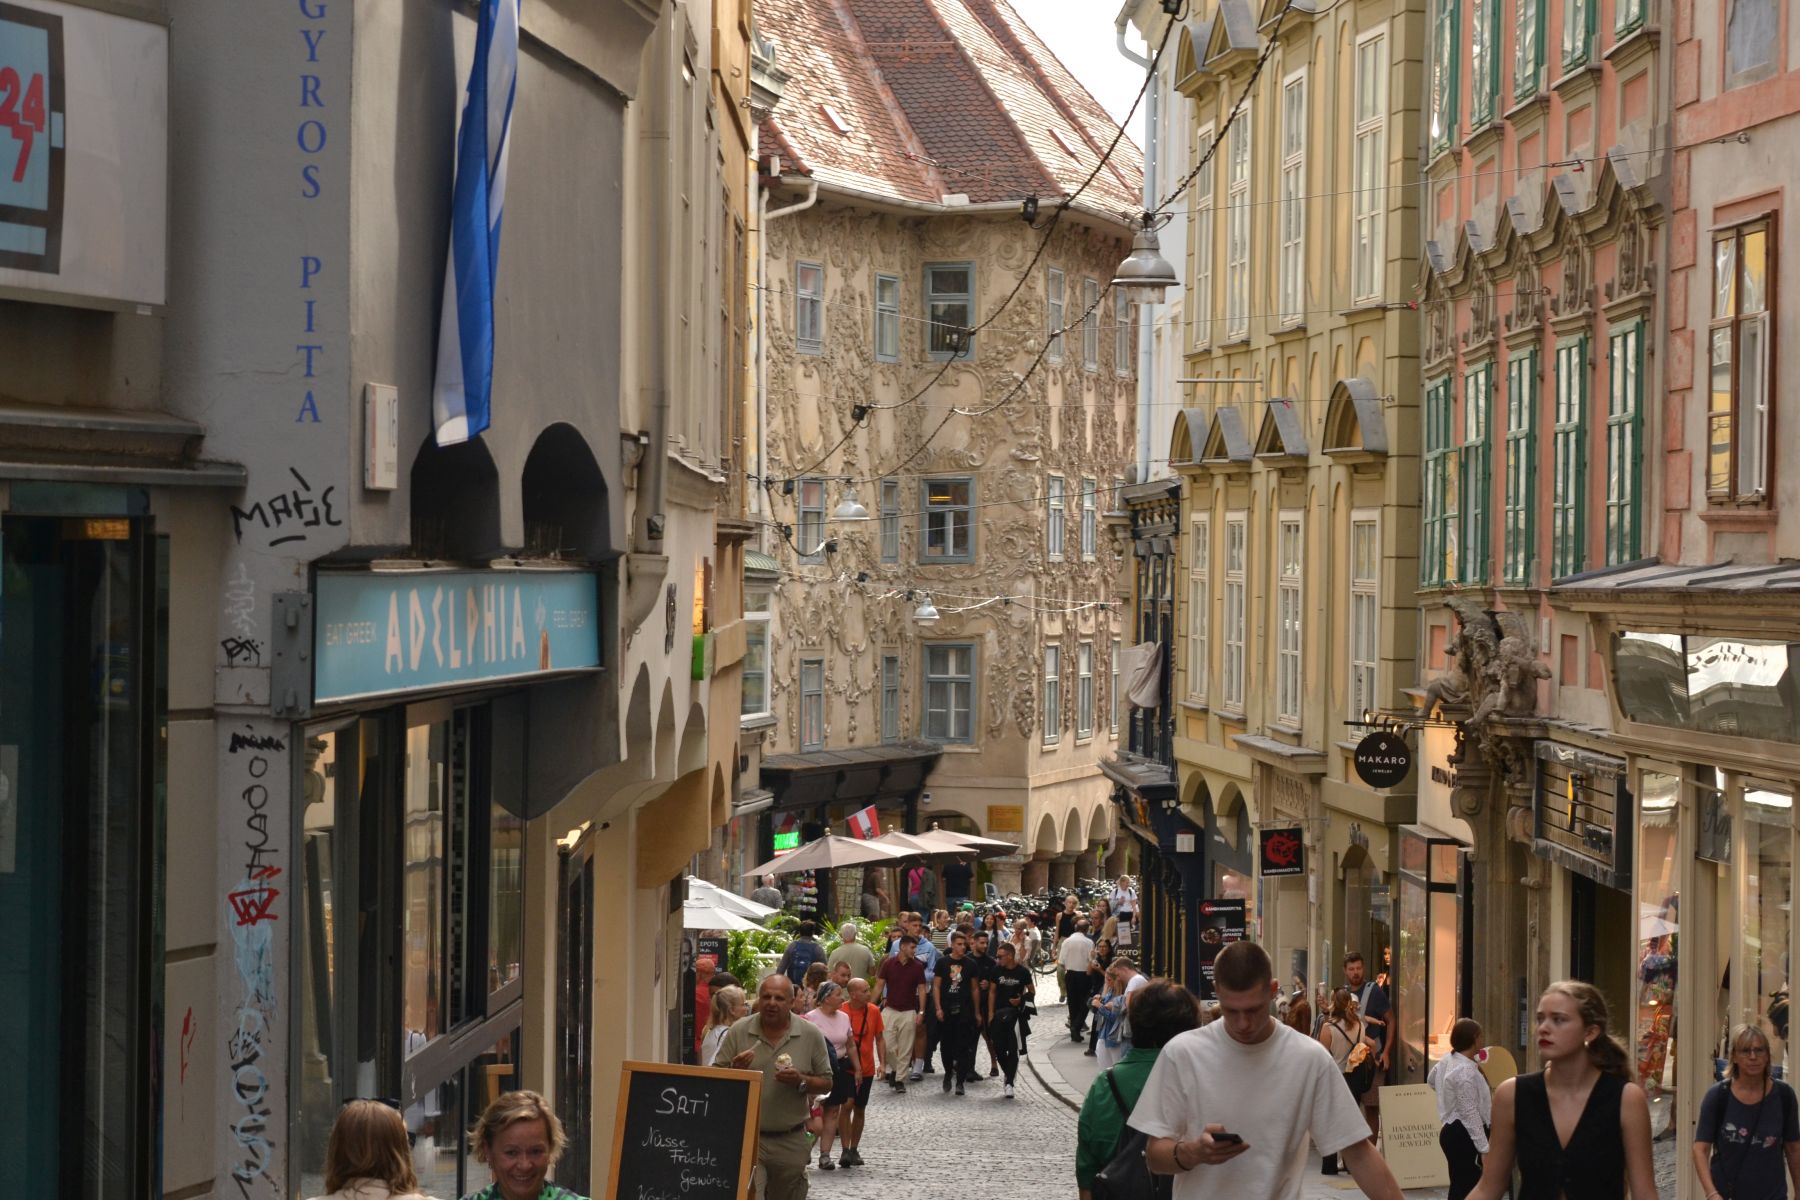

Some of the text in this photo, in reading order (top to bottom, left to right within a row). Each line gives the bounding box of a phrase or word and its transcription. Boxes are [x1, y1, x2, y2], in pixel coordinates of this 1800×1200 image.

[296, 0, 327, 423] GYROS PITA
[385, 584, 527, 673] ADELPHIA
[1358, 756, 1406, 765] MAKARO
[641, 1126, 688, 1148] Nüsse
[1388, 1132, 1404, 1141] FAIR
[1399, 1139, 1431, 1148] JEWELRY
[669, 1149, 718, 1167] Früchte
